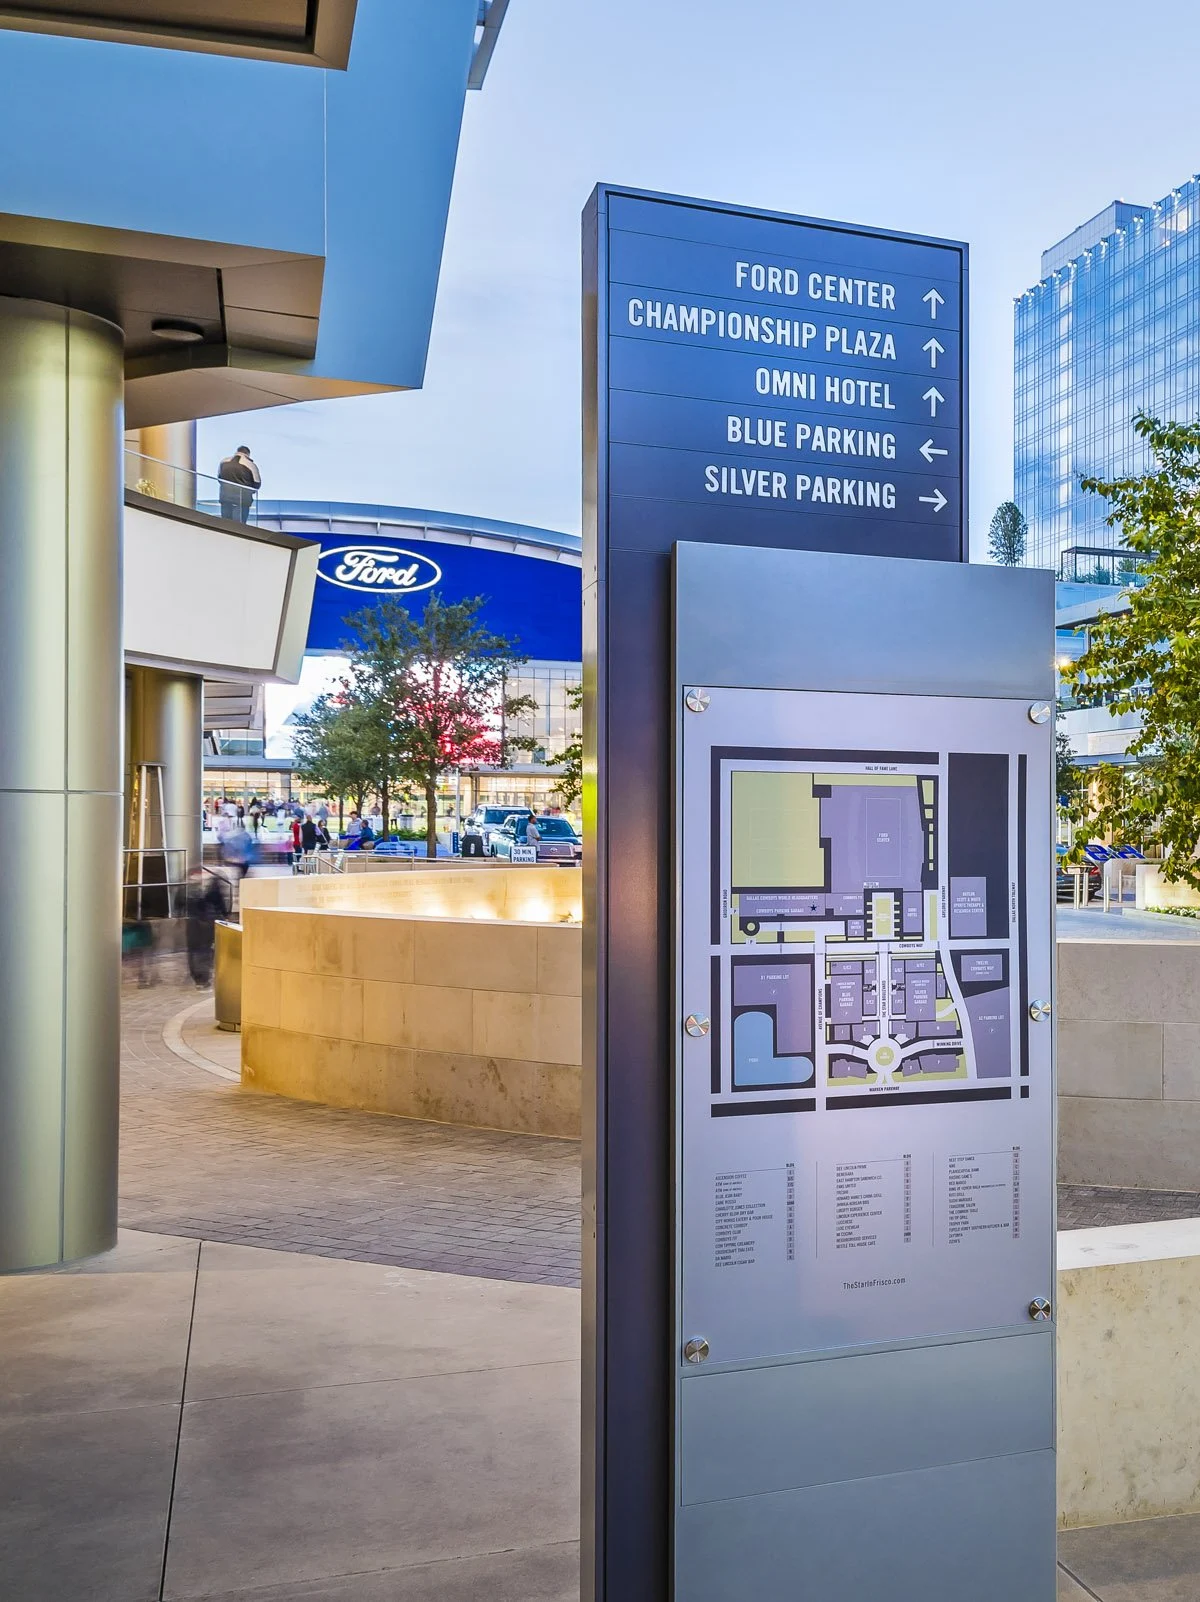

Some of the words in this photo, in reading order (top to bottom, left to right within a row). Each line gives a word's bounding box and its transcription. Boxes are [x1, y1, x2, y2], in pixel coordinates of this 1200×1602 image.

[736, 262, 798, 296] FORD
[808, 273, 896, 310] CENTER
[628, 299, 817, 349] CHAMPIONSHIP
[826, 326, 897, 360] PLAZA
[756, 368, 815, 400] OMNI
[826, 377, 896, 410] HOTEL
[727, 416, 787, 448] BLUE
[797, 424, 896, 458] PARKING
[704, 466, 787, 498] SILVER
[797, 475, 896, 509] PARKING
[335, 551, 419, 586] Ford
